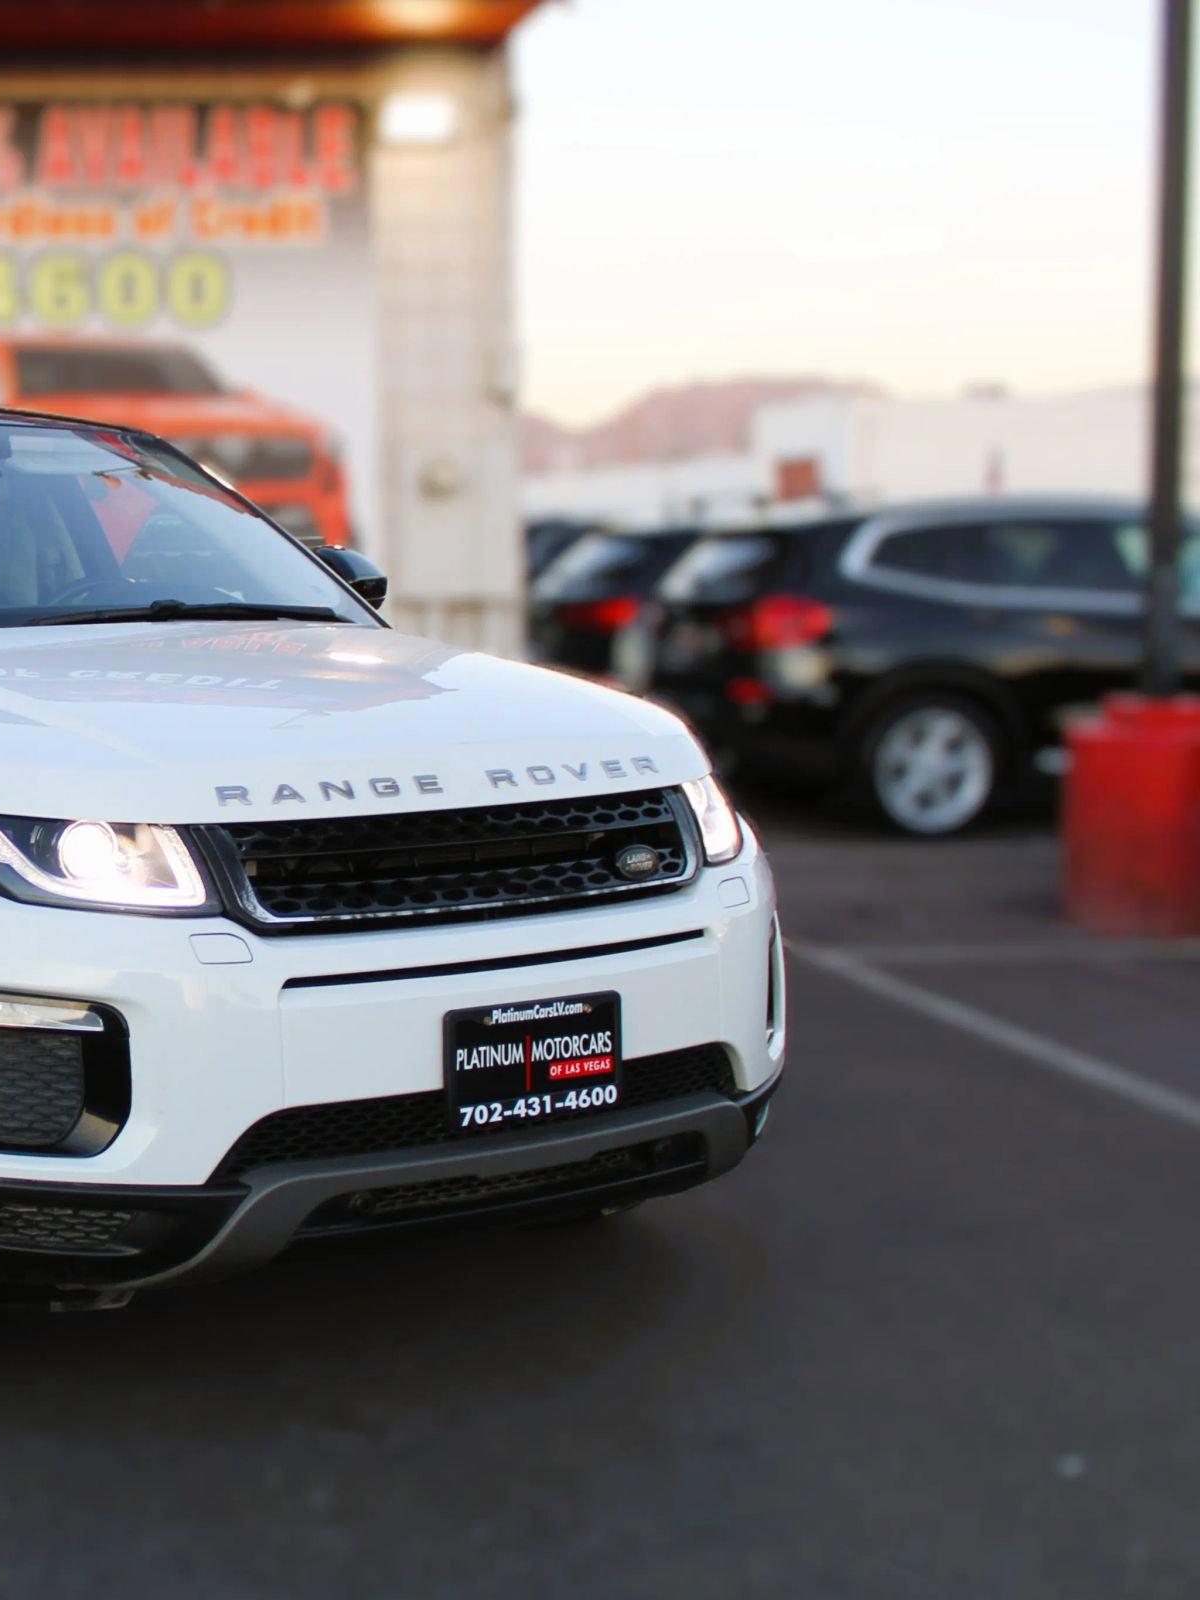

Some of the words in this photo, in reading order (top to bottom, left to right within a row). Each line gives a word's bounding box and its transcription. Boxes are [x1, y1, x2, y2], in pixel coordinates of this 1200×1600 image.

[38, 105, 355, 188] AVAILABLE
[134, 202, 176, 240] of
[190, 197, 322, 241] Credit
[215, 774, 444, 807] RANGE
[485, 755, 660, 790] ROVER
[492, 1001, 583, 1025] PlatinumCarsLV.com
[456, 1042, 524, 1071] PLATINUM
[531, 1031, 612, 1062] MOTORCARS
[550, 1065, 562, 1076] OF
[565, 1063, 580, 1075] LAS
[584, 1059, 611, 1072] VEGAS
[460, 1085, 618, 1127] 702-431-4600
